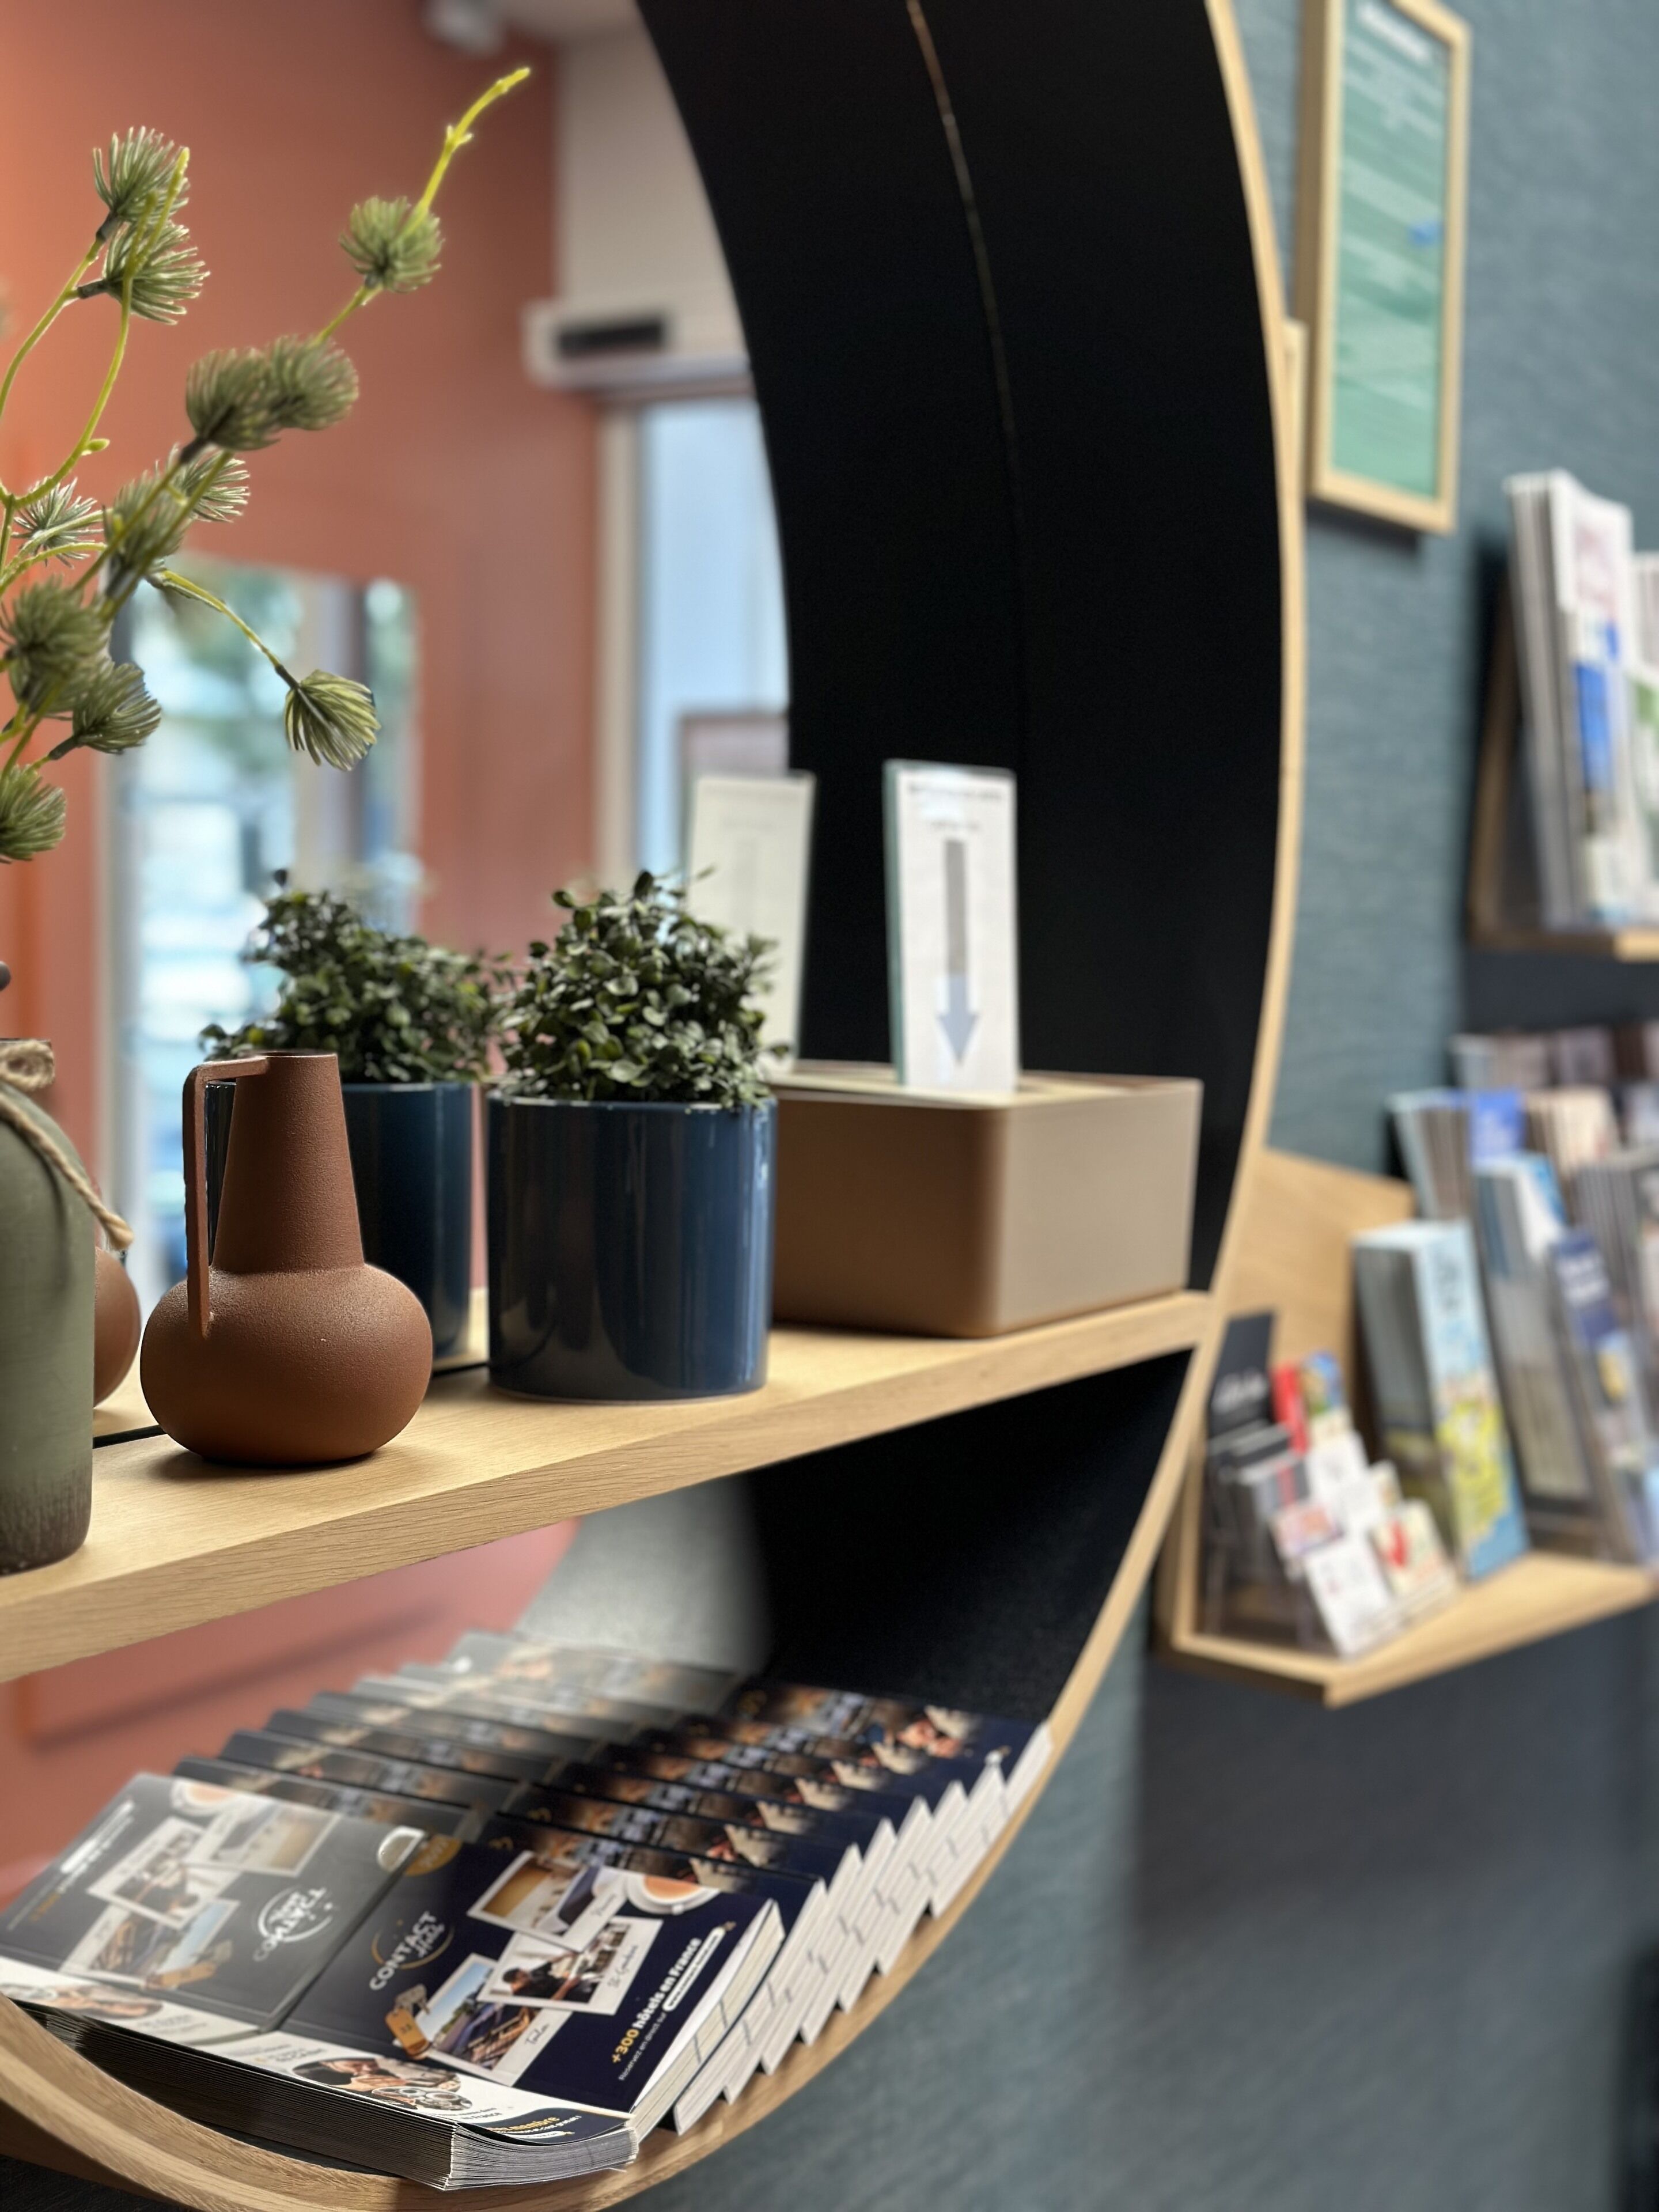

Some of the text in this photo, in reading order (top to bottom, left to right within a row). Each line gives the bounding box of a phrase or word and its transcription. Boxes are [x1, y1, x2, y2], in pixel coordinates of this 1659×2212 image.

[369, 1911, 437, 1990] CONTACT
[611, 1937, 702, 2064] +300 hôtels en France
[639, 2041, 648, 2051] en
[645, 2022, 661, 2042] direct
